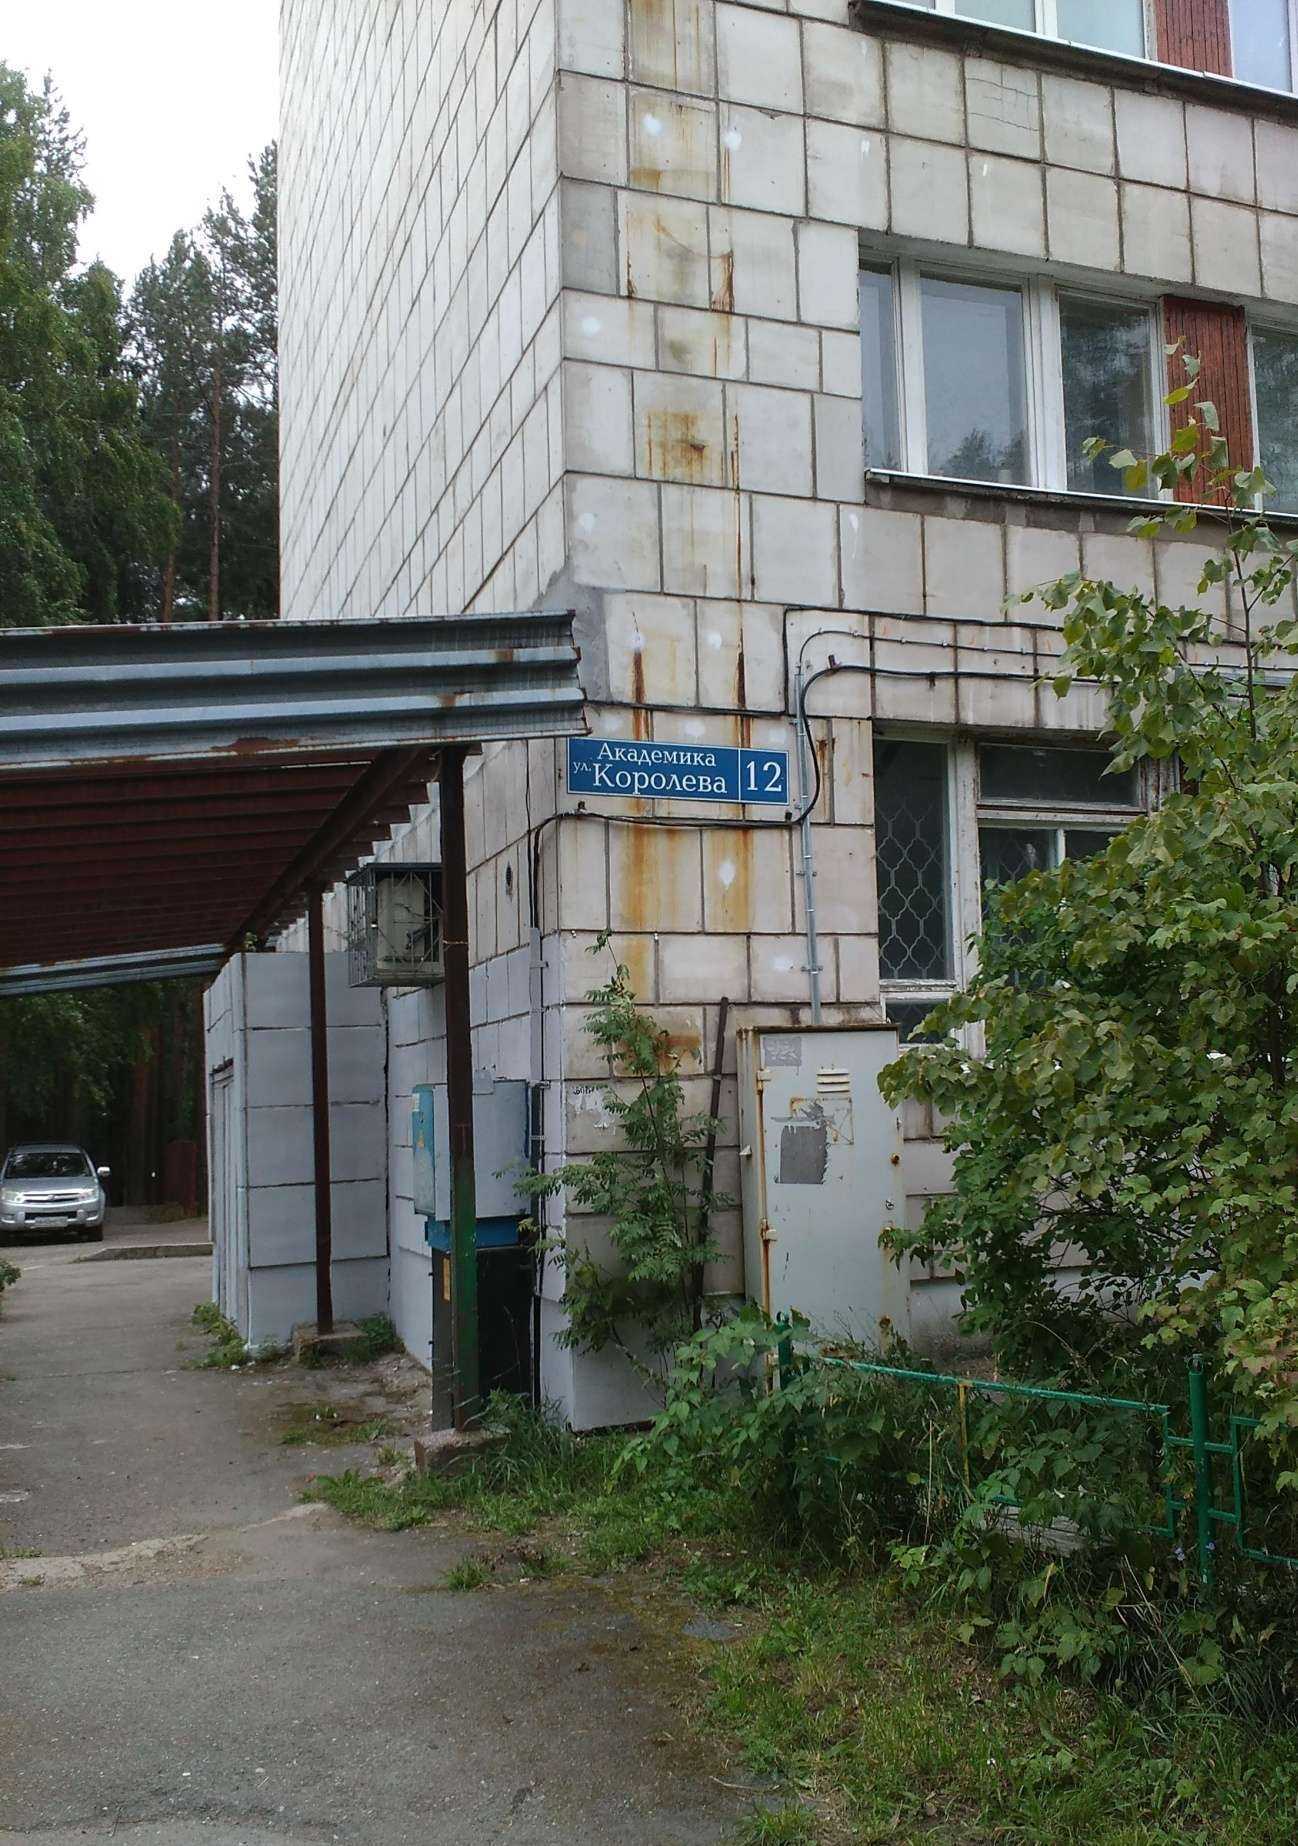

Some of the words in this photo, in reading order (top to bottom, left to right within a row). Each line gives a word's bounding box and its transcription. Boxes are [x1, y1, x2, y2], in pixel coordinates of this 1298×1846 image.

[597, 742, 716, 767] Академика
[573, 761, 592, 773] ул.
[592, 762, 728, 795] Королева
[746, 760, 783, 793] 12
